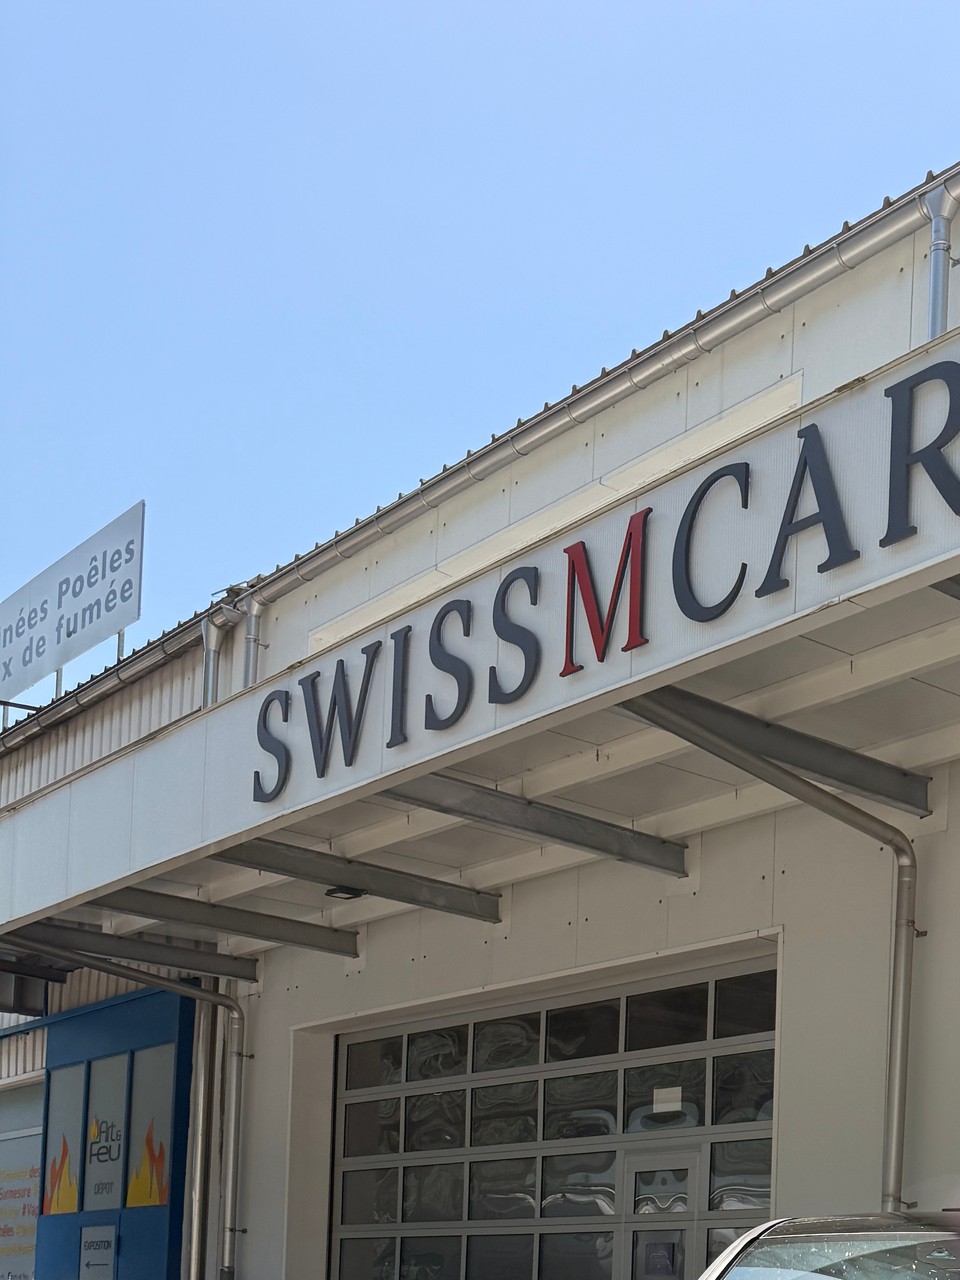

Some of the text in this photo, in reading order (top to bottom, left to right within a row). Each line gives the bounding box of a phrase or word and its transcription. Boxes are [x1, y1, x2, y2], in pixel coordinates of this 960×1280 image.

[0, 538, 135, 649] nées Poêles
[22, 635, 47, 668] de
[55, 577, 134, 646] fumée
[89, 1140, 121, 1165] Feu
